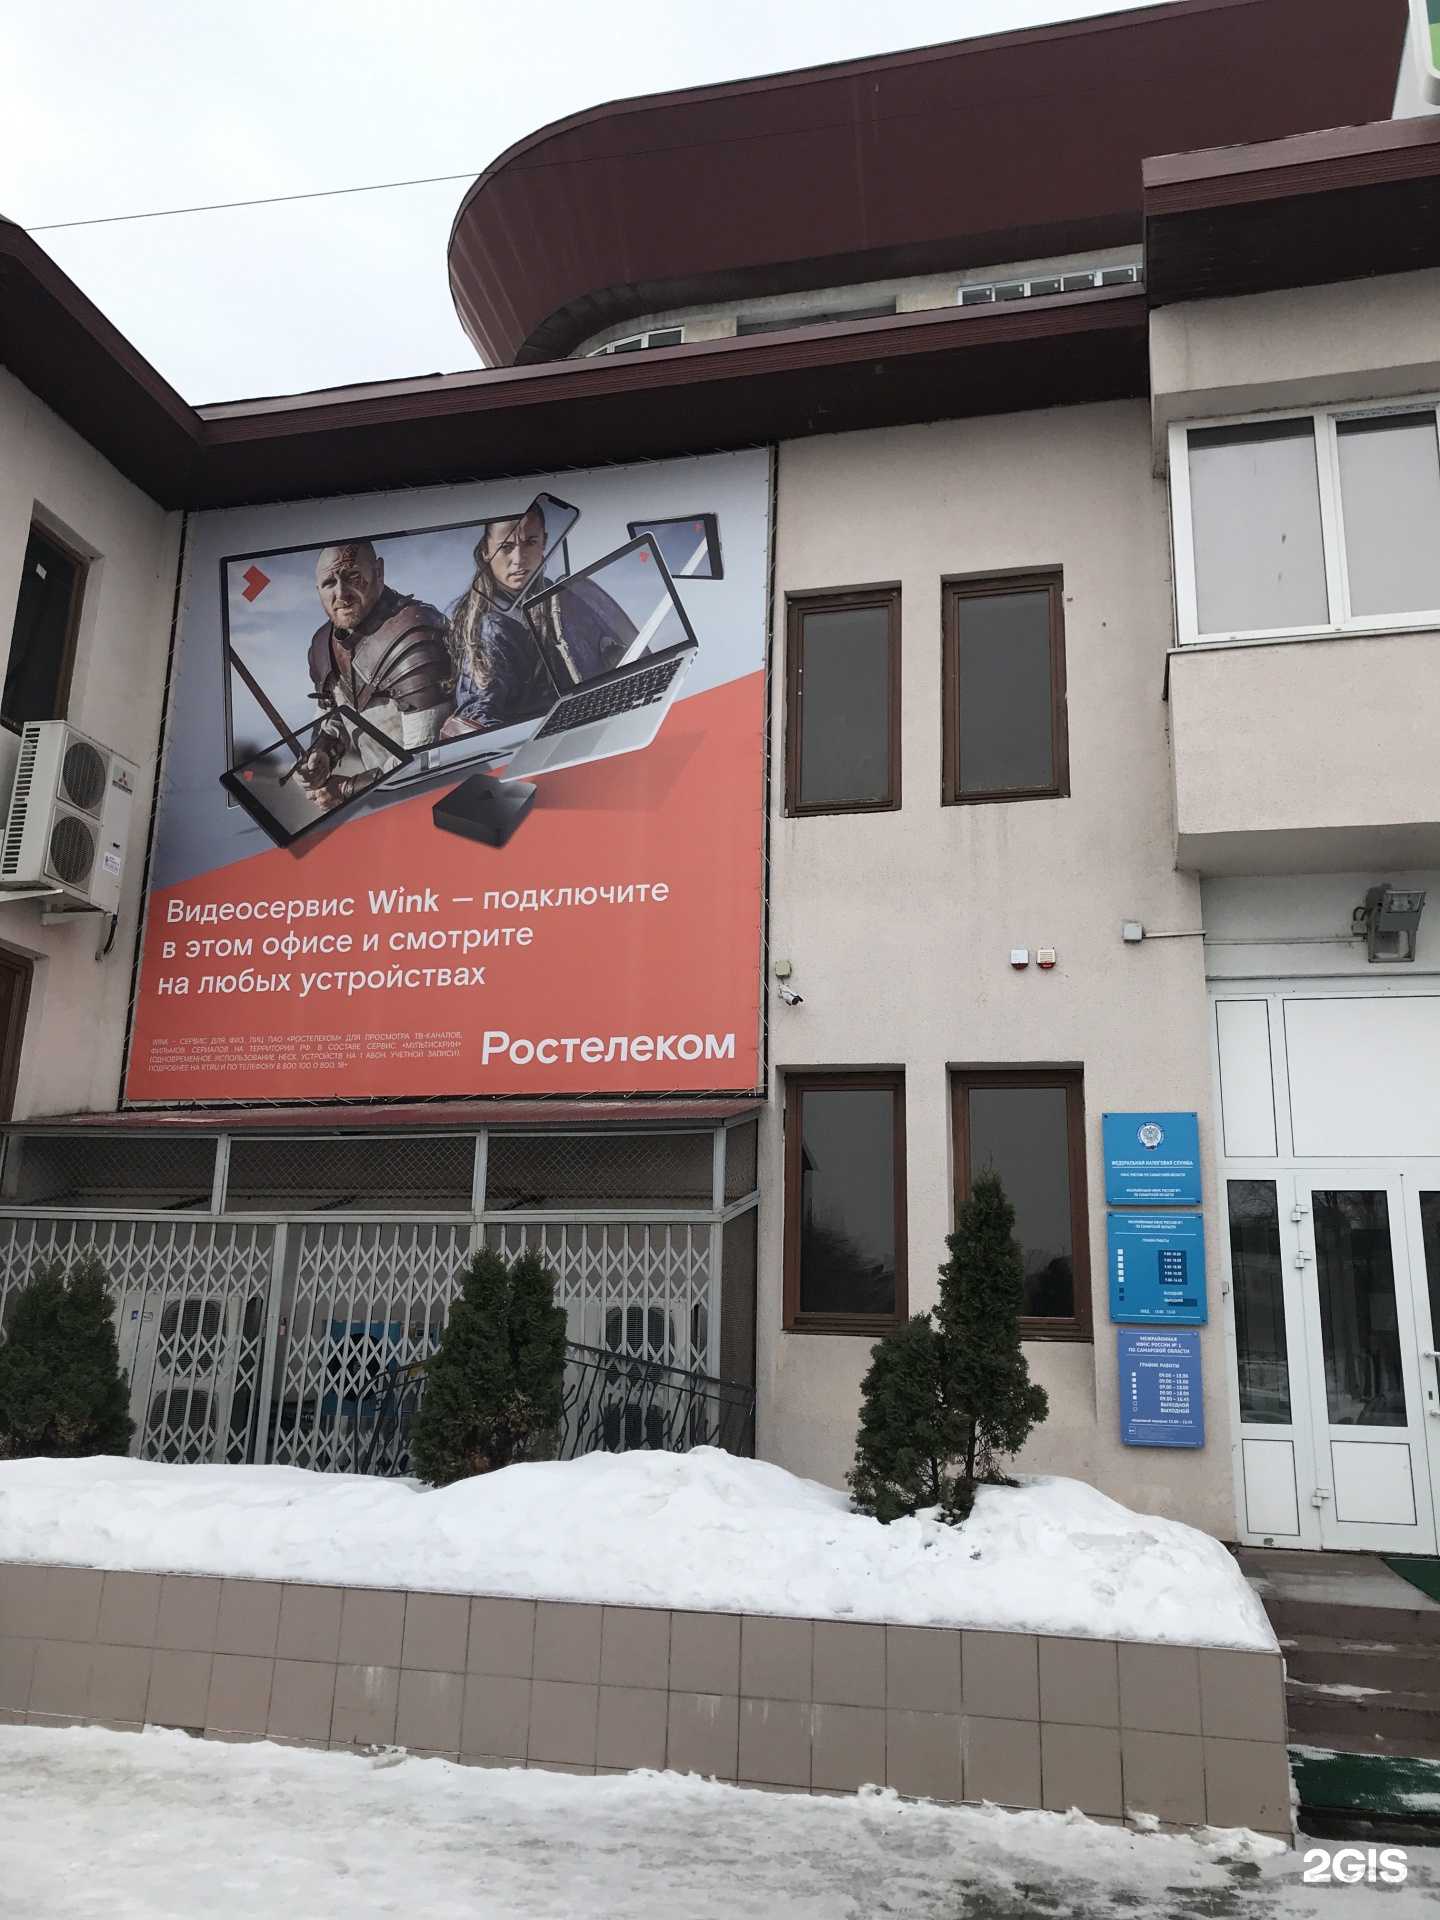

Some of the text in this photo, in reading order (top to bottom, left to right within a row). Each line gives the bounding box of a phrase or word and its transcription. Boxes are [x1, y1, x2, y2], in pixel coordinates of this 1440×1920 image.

[167, 896, 355, 925] Видеосервис
[367, 885, 440, 915] Wink
[483, 881, 671, 911] подключите
[162, 926, 535, 960] в этом офисе и смотрите
[157, 964, 487, 998] на любых устройствах
[481, 1031, 735, 1065] Ростелеком
